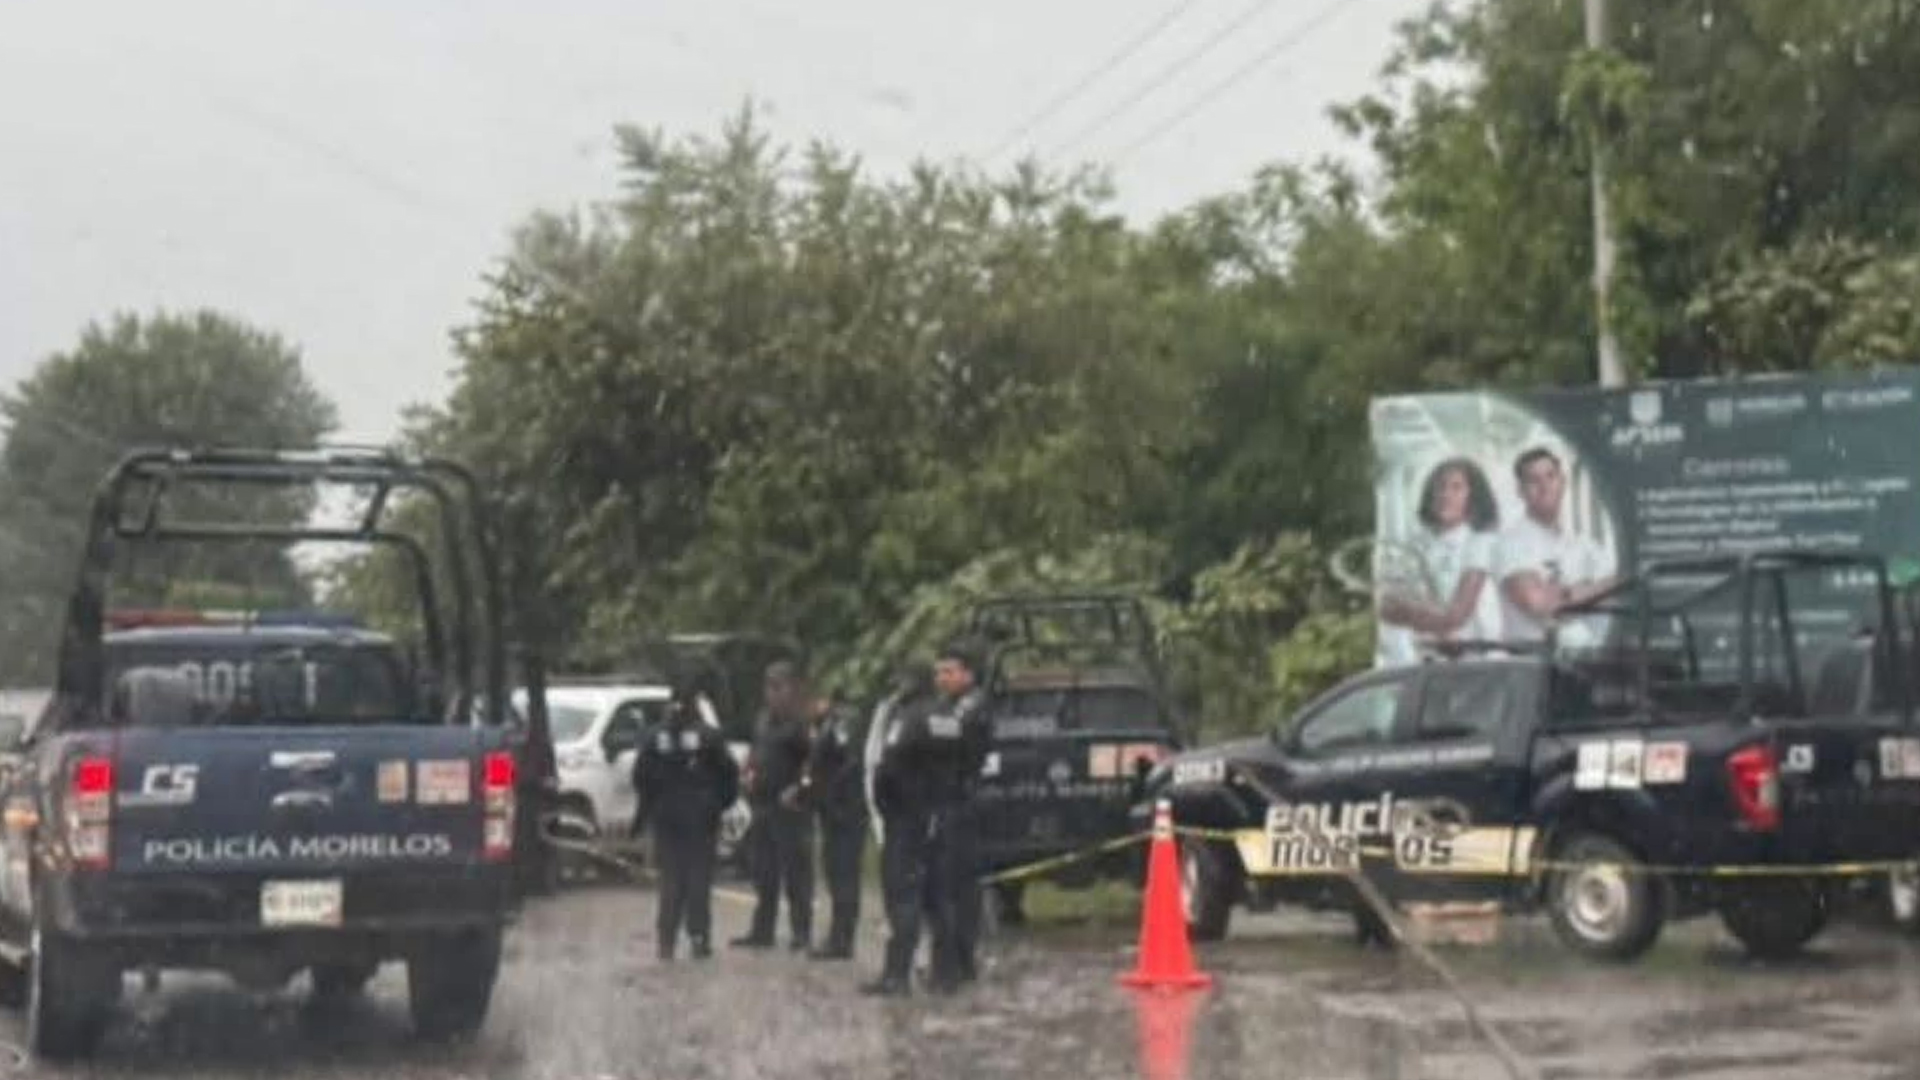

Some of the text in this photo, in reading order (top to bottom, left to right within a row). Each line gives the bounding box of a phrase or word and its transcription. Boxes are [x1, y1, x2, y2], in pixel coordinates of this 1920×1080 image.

[143, 764, 200, 799] CS
[144, 833, 453, 863] POLICÍA MORELOS
